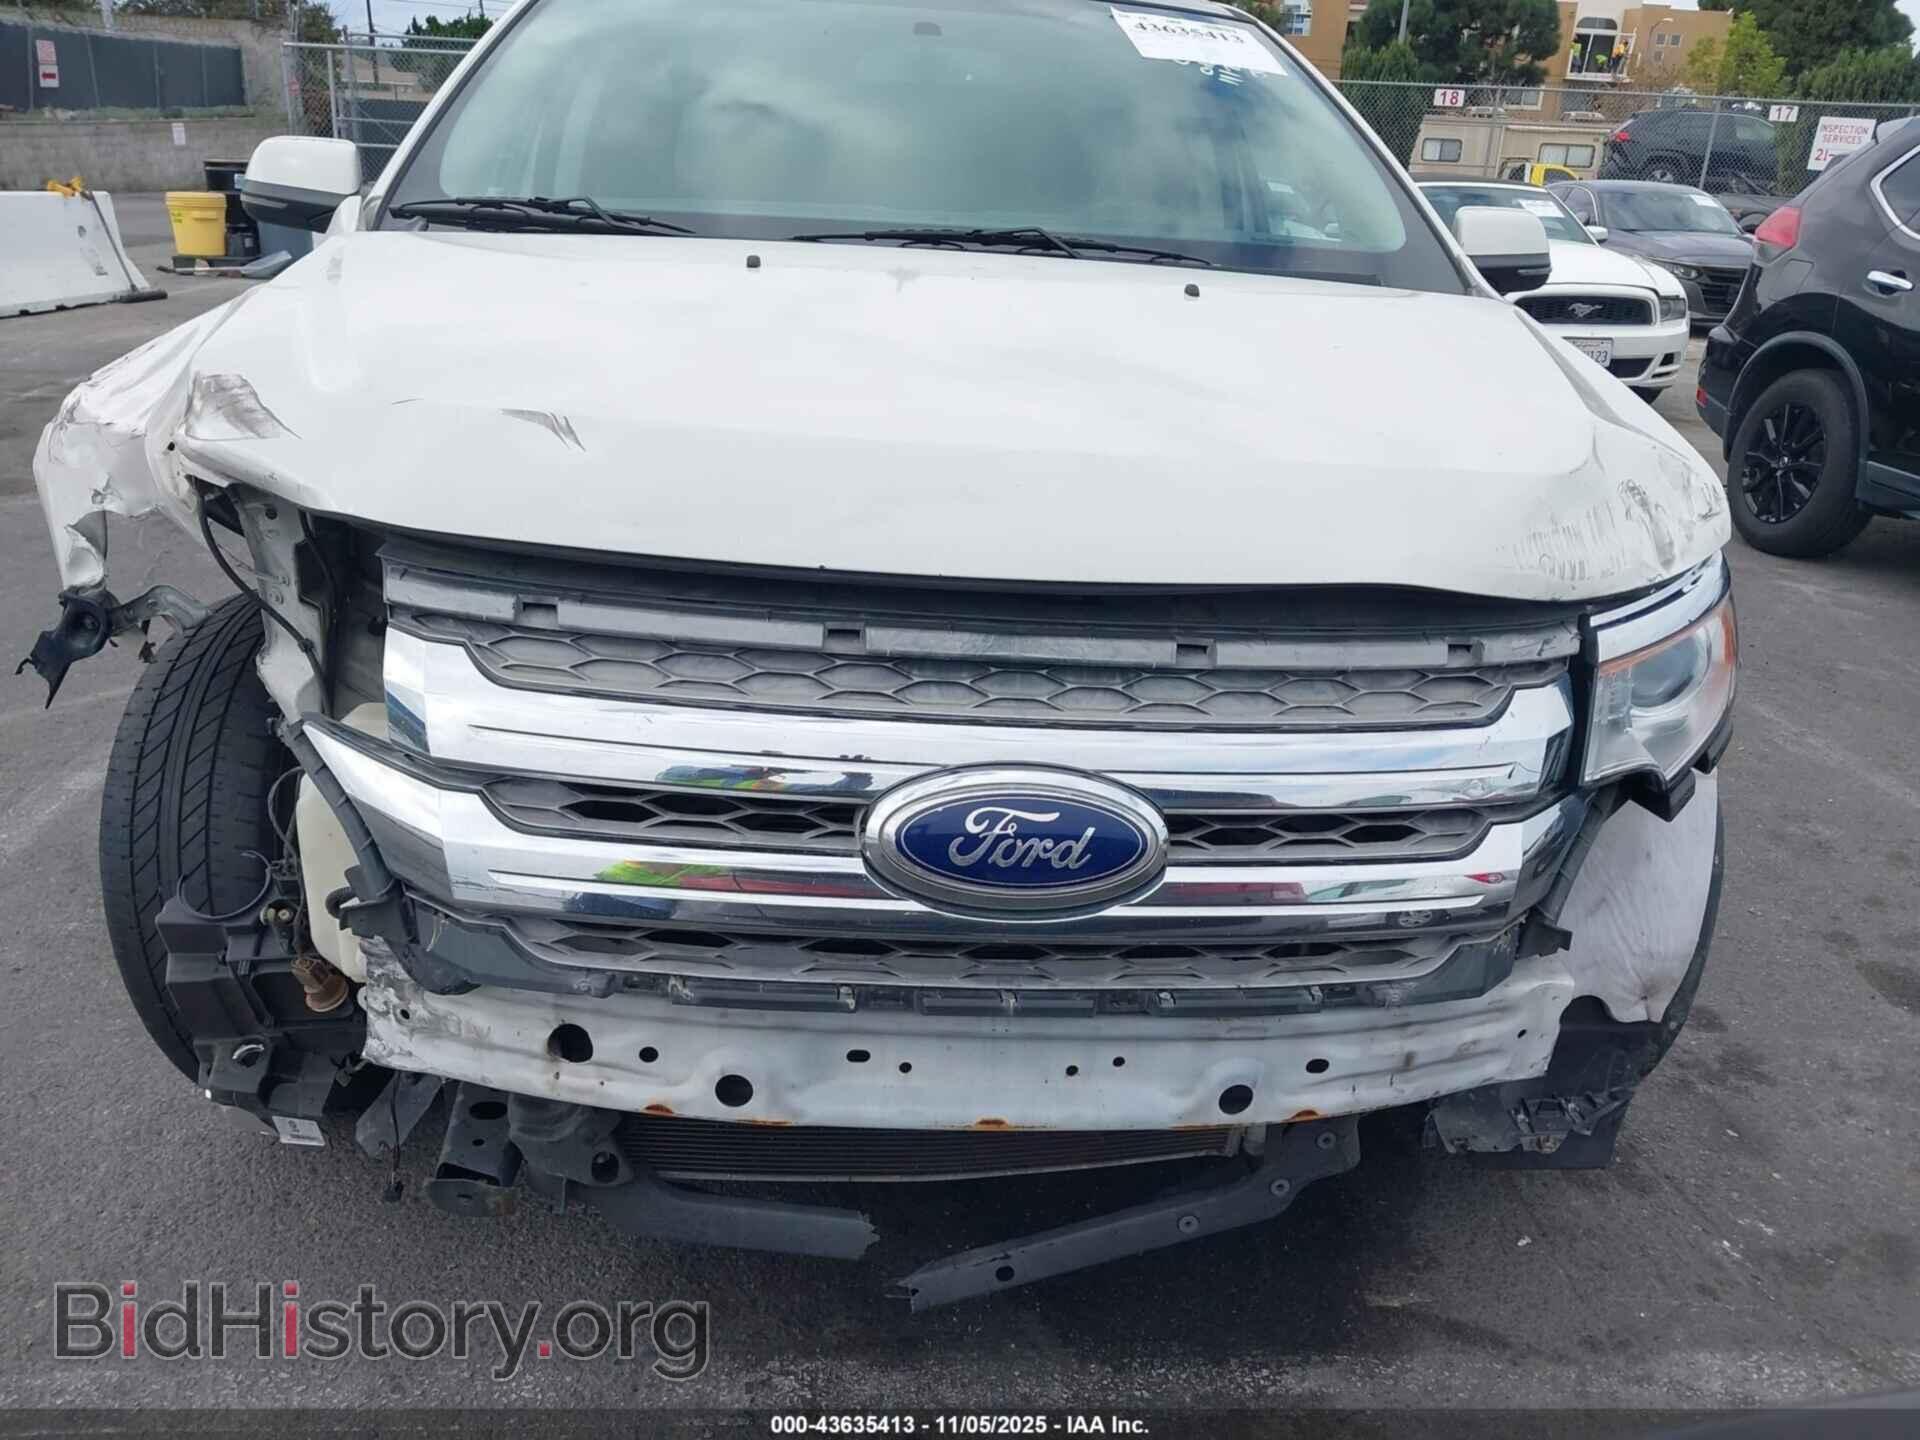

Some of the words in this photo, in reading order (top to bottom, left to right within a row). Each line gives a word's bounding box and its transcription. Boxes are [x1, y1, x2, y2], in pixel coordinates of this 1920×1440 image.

[1440, 90, 1459, 105] 18
[1776, 106, 1794, 120] 17
[1820, 124, 1869, 135] INSPECTION
[1822, 134, 1862, 145] SERVICES
[948, 806, 1096, 870] Ford
